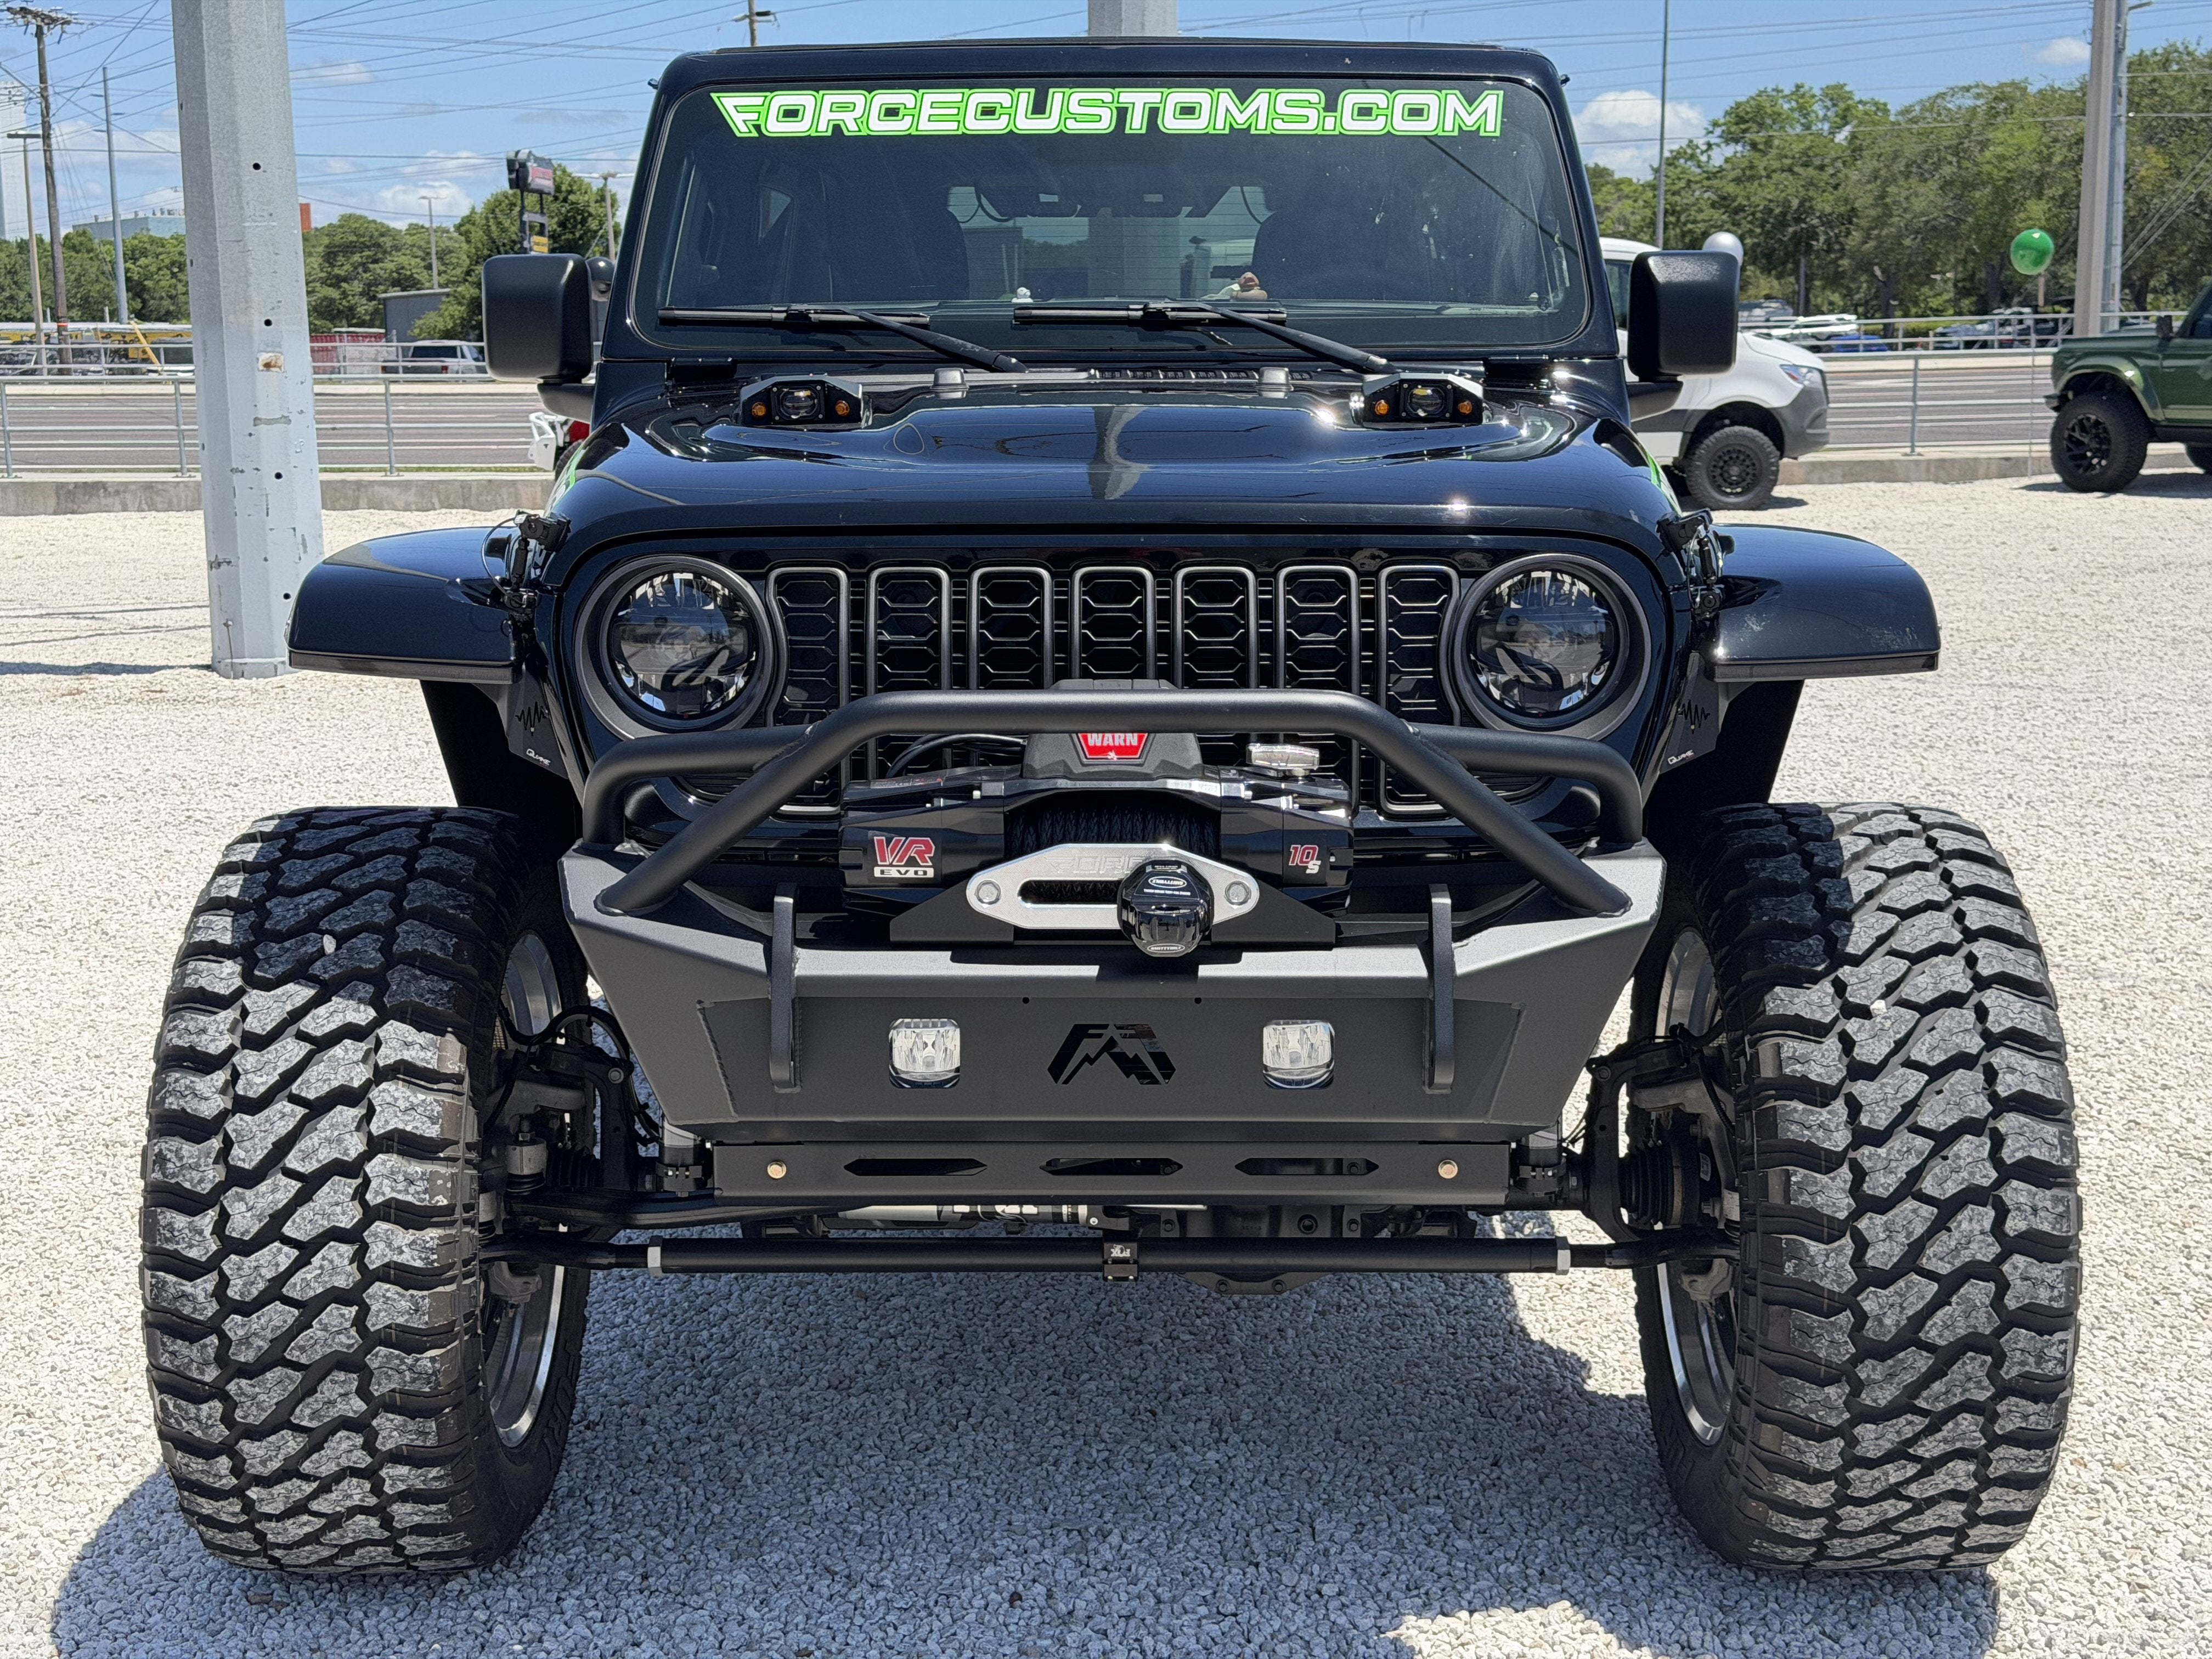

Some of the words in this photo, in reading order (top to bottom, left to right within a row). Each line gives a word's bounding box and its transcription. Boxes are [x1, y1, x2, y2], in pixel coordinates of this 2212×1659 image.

[710, 88, 1504, 137] FORCECUSTOMS.COM
[1087, 733, 1138, 746] WARN
[873, 836, 935, 866] VR
[1110, 1244, 1131, 1257] FOX
